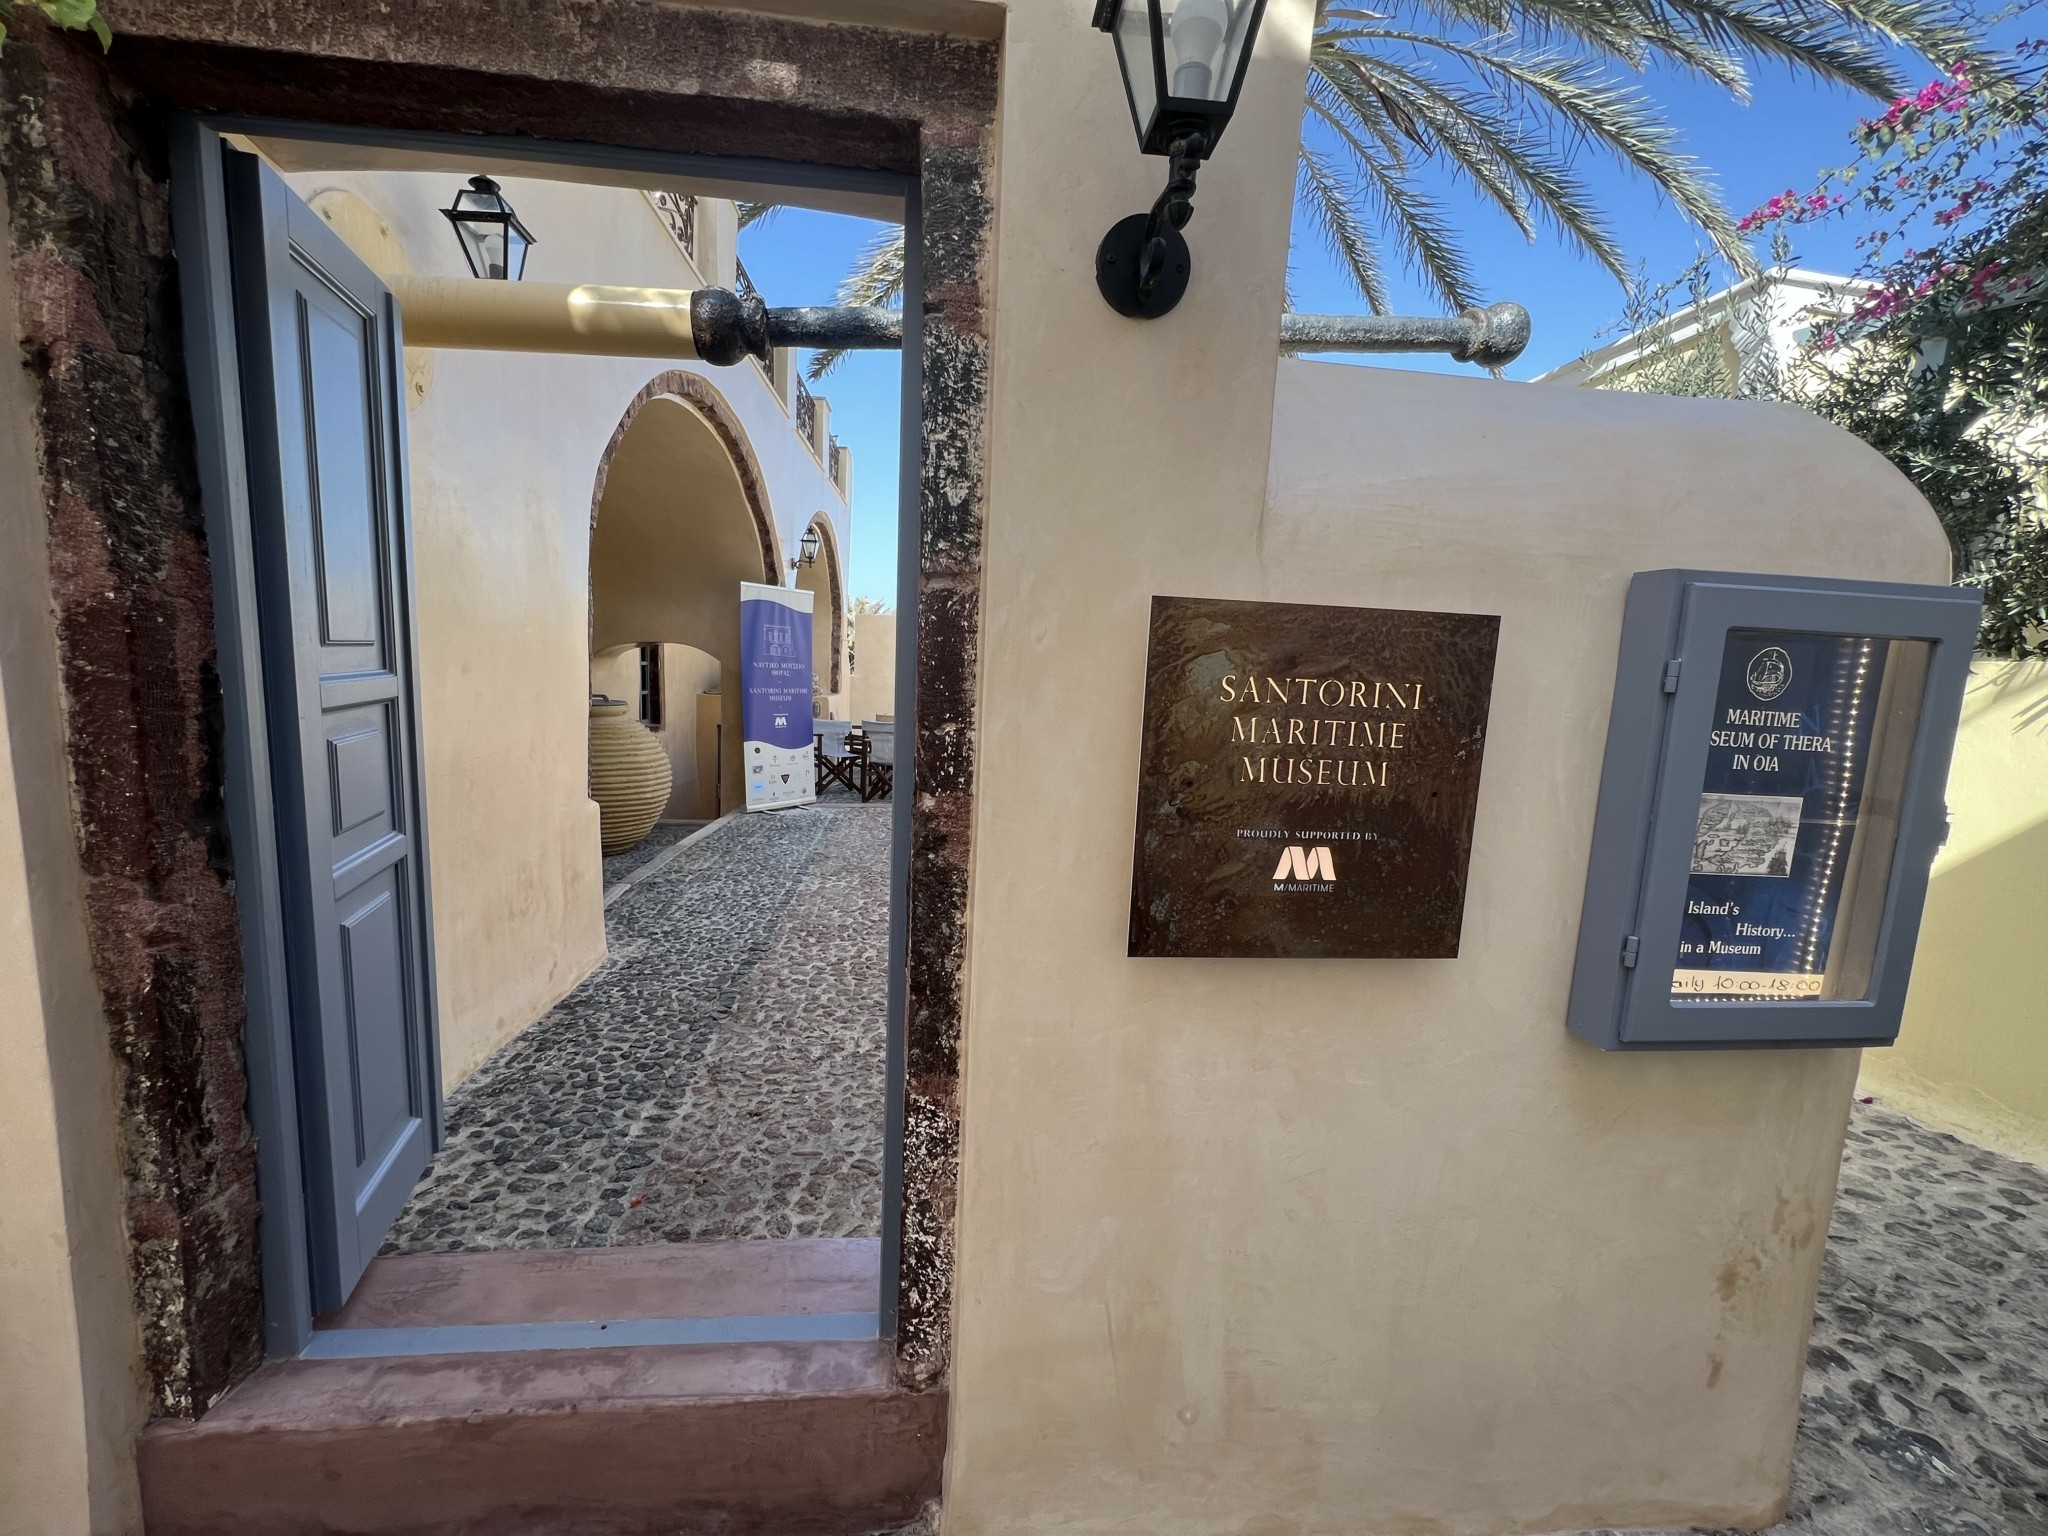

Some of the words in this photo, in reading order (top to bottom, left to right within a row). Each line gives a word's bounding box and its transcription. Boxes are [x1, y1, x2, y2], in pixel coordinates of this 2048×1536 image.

[1219, 674, 1423, 710] SANTORINI
[1726, 708, 1802, 728] MARITIME
[1231, 716, 1405, 748] MARITIME
[1710, 730, 1755, 748] SEUM
[1759, 733, 1780, 749] OF
[1783, 734, 1832, 752] THERA
[1239, 756, 1389, 787] MUSEUM
[1732, 754, 1750, 770] IN
[1753, 755, 1779, 772] OIA
[1236, 829, 1291, 838] PROUDLY
[1295, 830, 1361, 840] SUPPORTED
[1365, 832, 1379, 841] BY
[1688, 900, 1740, 915] Island's
[1735, 922, 1796, 939] History...
[1680, 941, 1692, 953] in
[1696, 945, 1704, 953] a
[1708, 940, 1761, 955] Museum
[1671, 975, 1705, 992] aily
